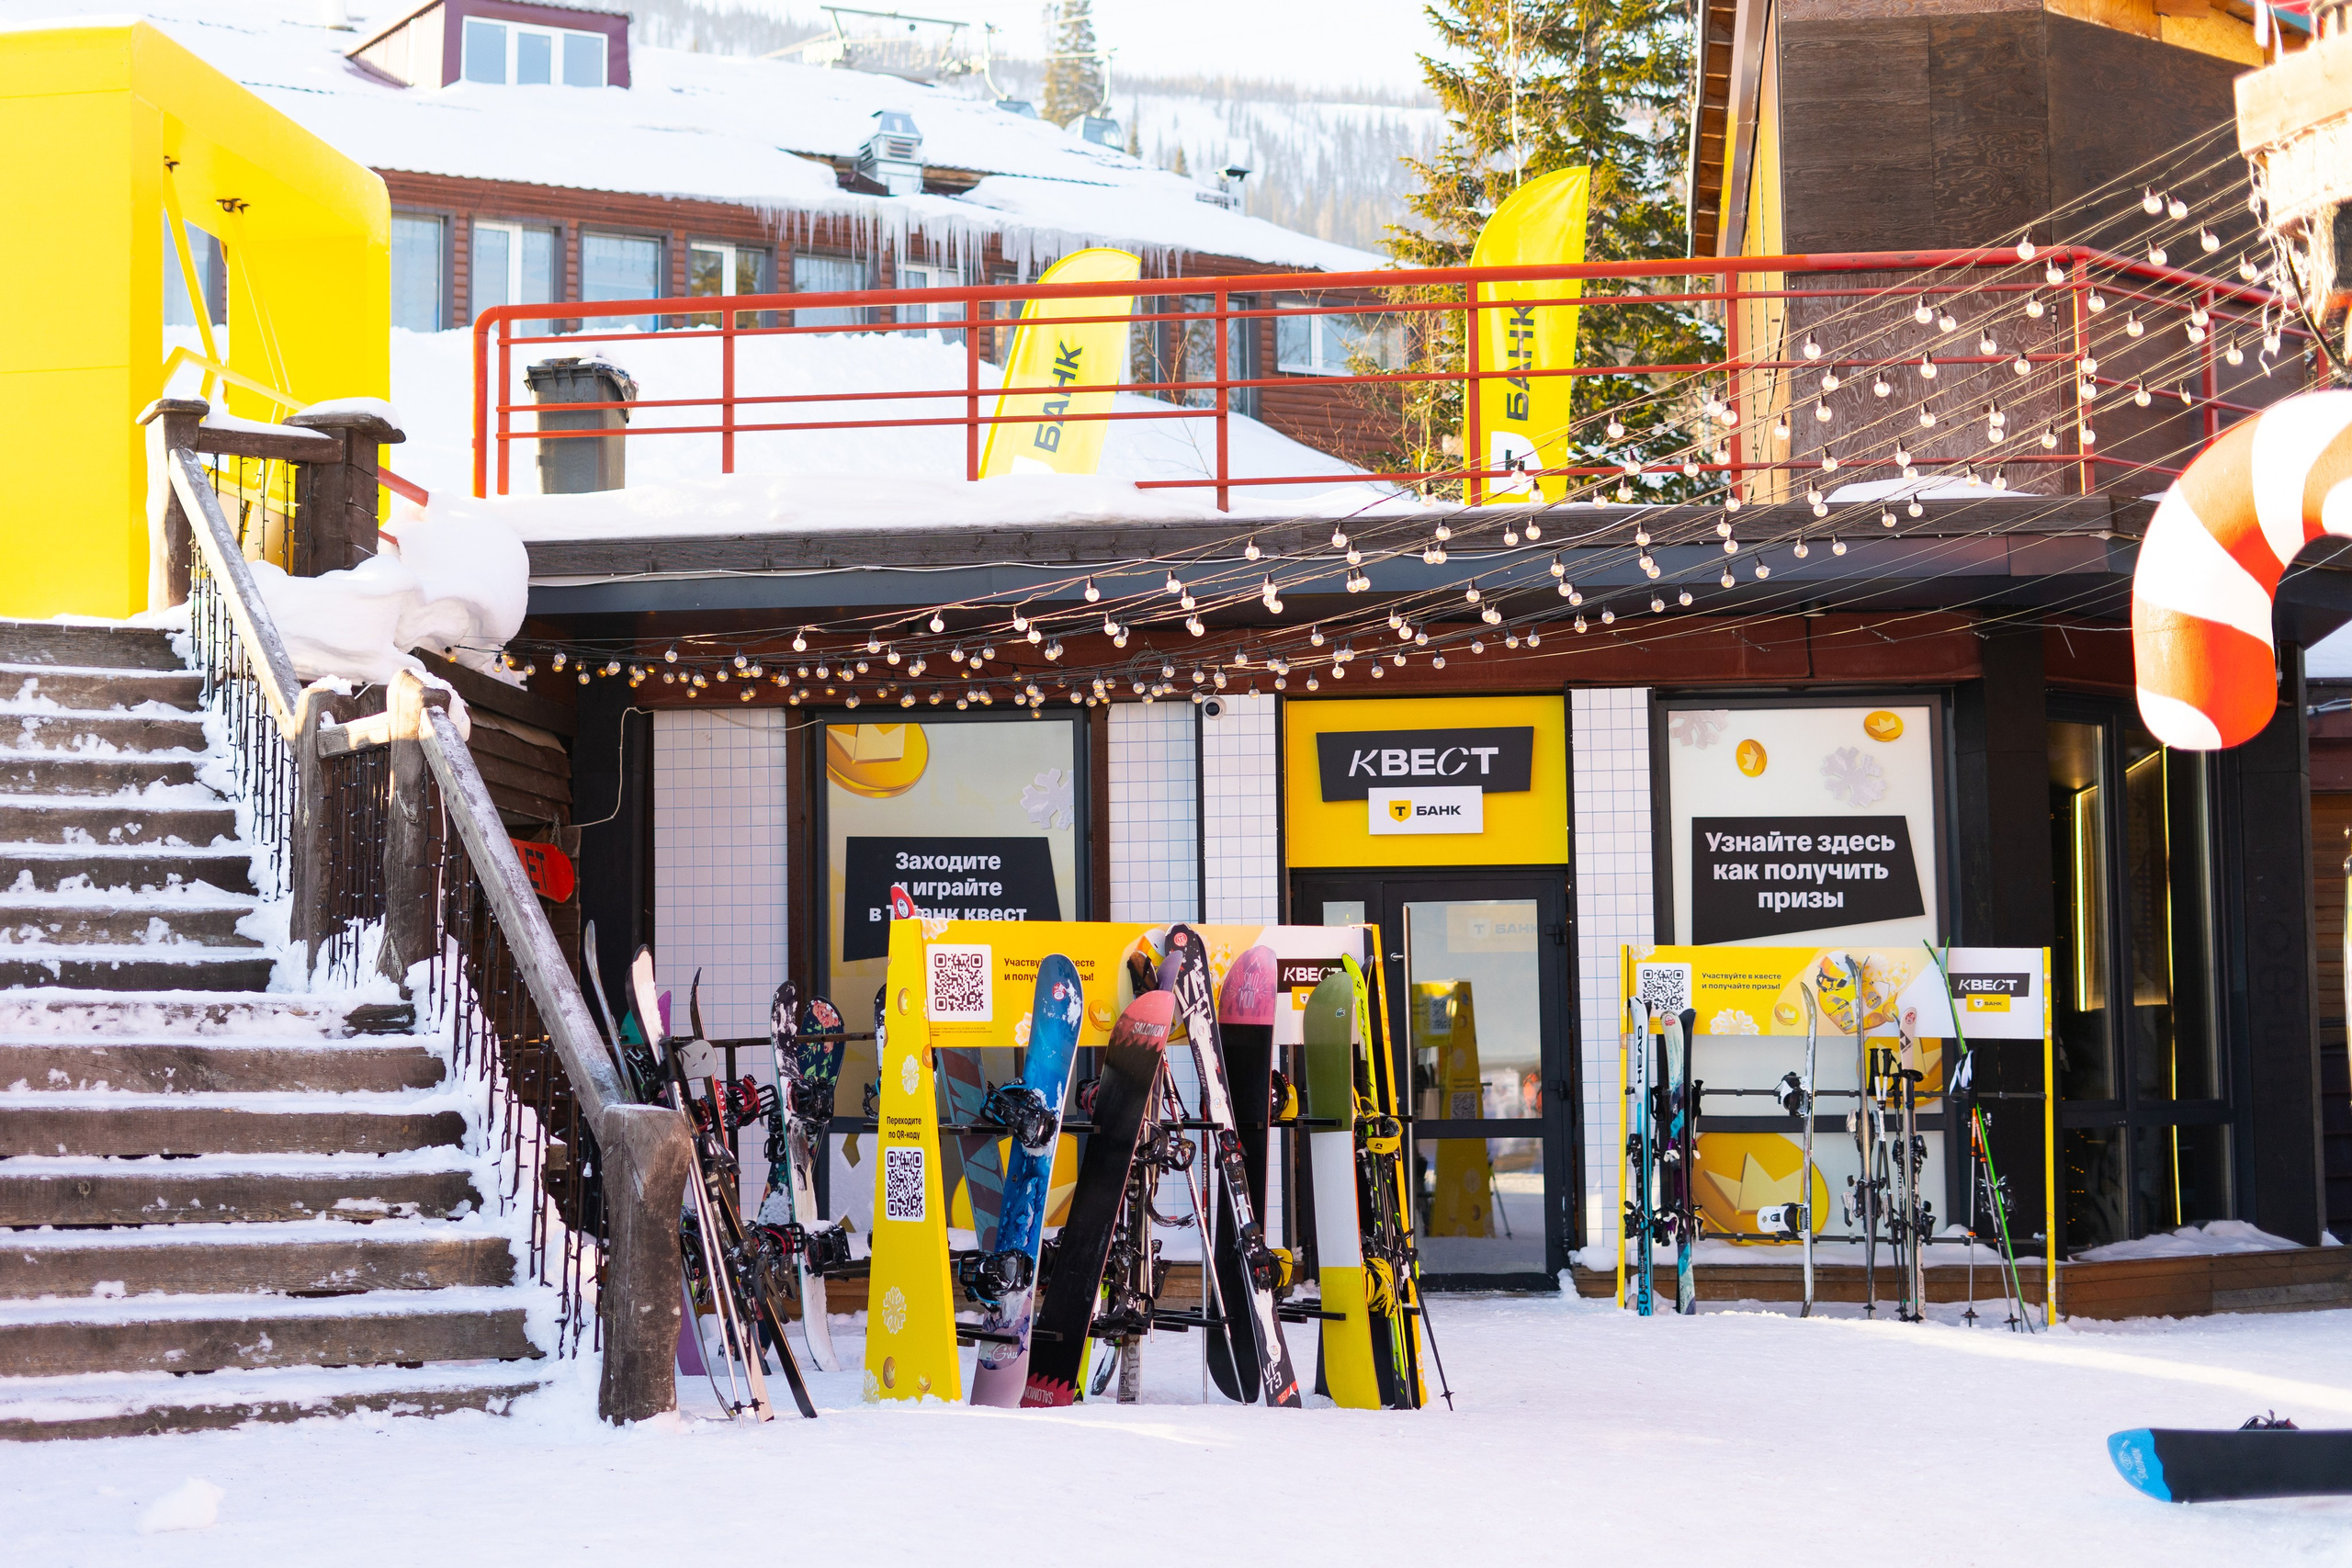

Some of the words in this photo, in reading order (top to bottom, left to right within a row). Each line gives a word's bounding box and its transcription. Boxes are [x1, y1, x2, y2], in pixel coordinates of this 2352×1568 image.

[1507, 298, 1535, 422] БАНК
[1034, 340, 1082, 453] БАНК
[1348, 747, 1498, 777] КВЕСТ
[1395, 806, 1406, 817] Т
[1416, 805, 1462, 817] БАНК
[1704, 830, 1812, 852] Узнайте
[1817, 834, 1895, 854] здесь
[895, 852, 1001, 873] Заходите
[1713, 863, 1759, 880] как
[1765, 863, 1889, 885] получить
[913, 877, 1002, 900] играйте
[1758, 891, 1844, 913] призы
[869, 907, 882, 921] в
[965, 908, 1027, 921] квест
[1004, 958, 1042, 968] Участву
[1072, 959, 1095, 967] есте
[1012, 974, 1037, 983] полу
[1080, 973, 1094, 981] зы!
[1958, 979, 2018, 991] КВЕСТ
[1132, 1021, 1166, 1038] SALOMON
[887, 1116, 922, 1125] Переходите
[897, 1130, 921, 1141] QR-коду
[1266, 1371, 1283, 1393] 73
